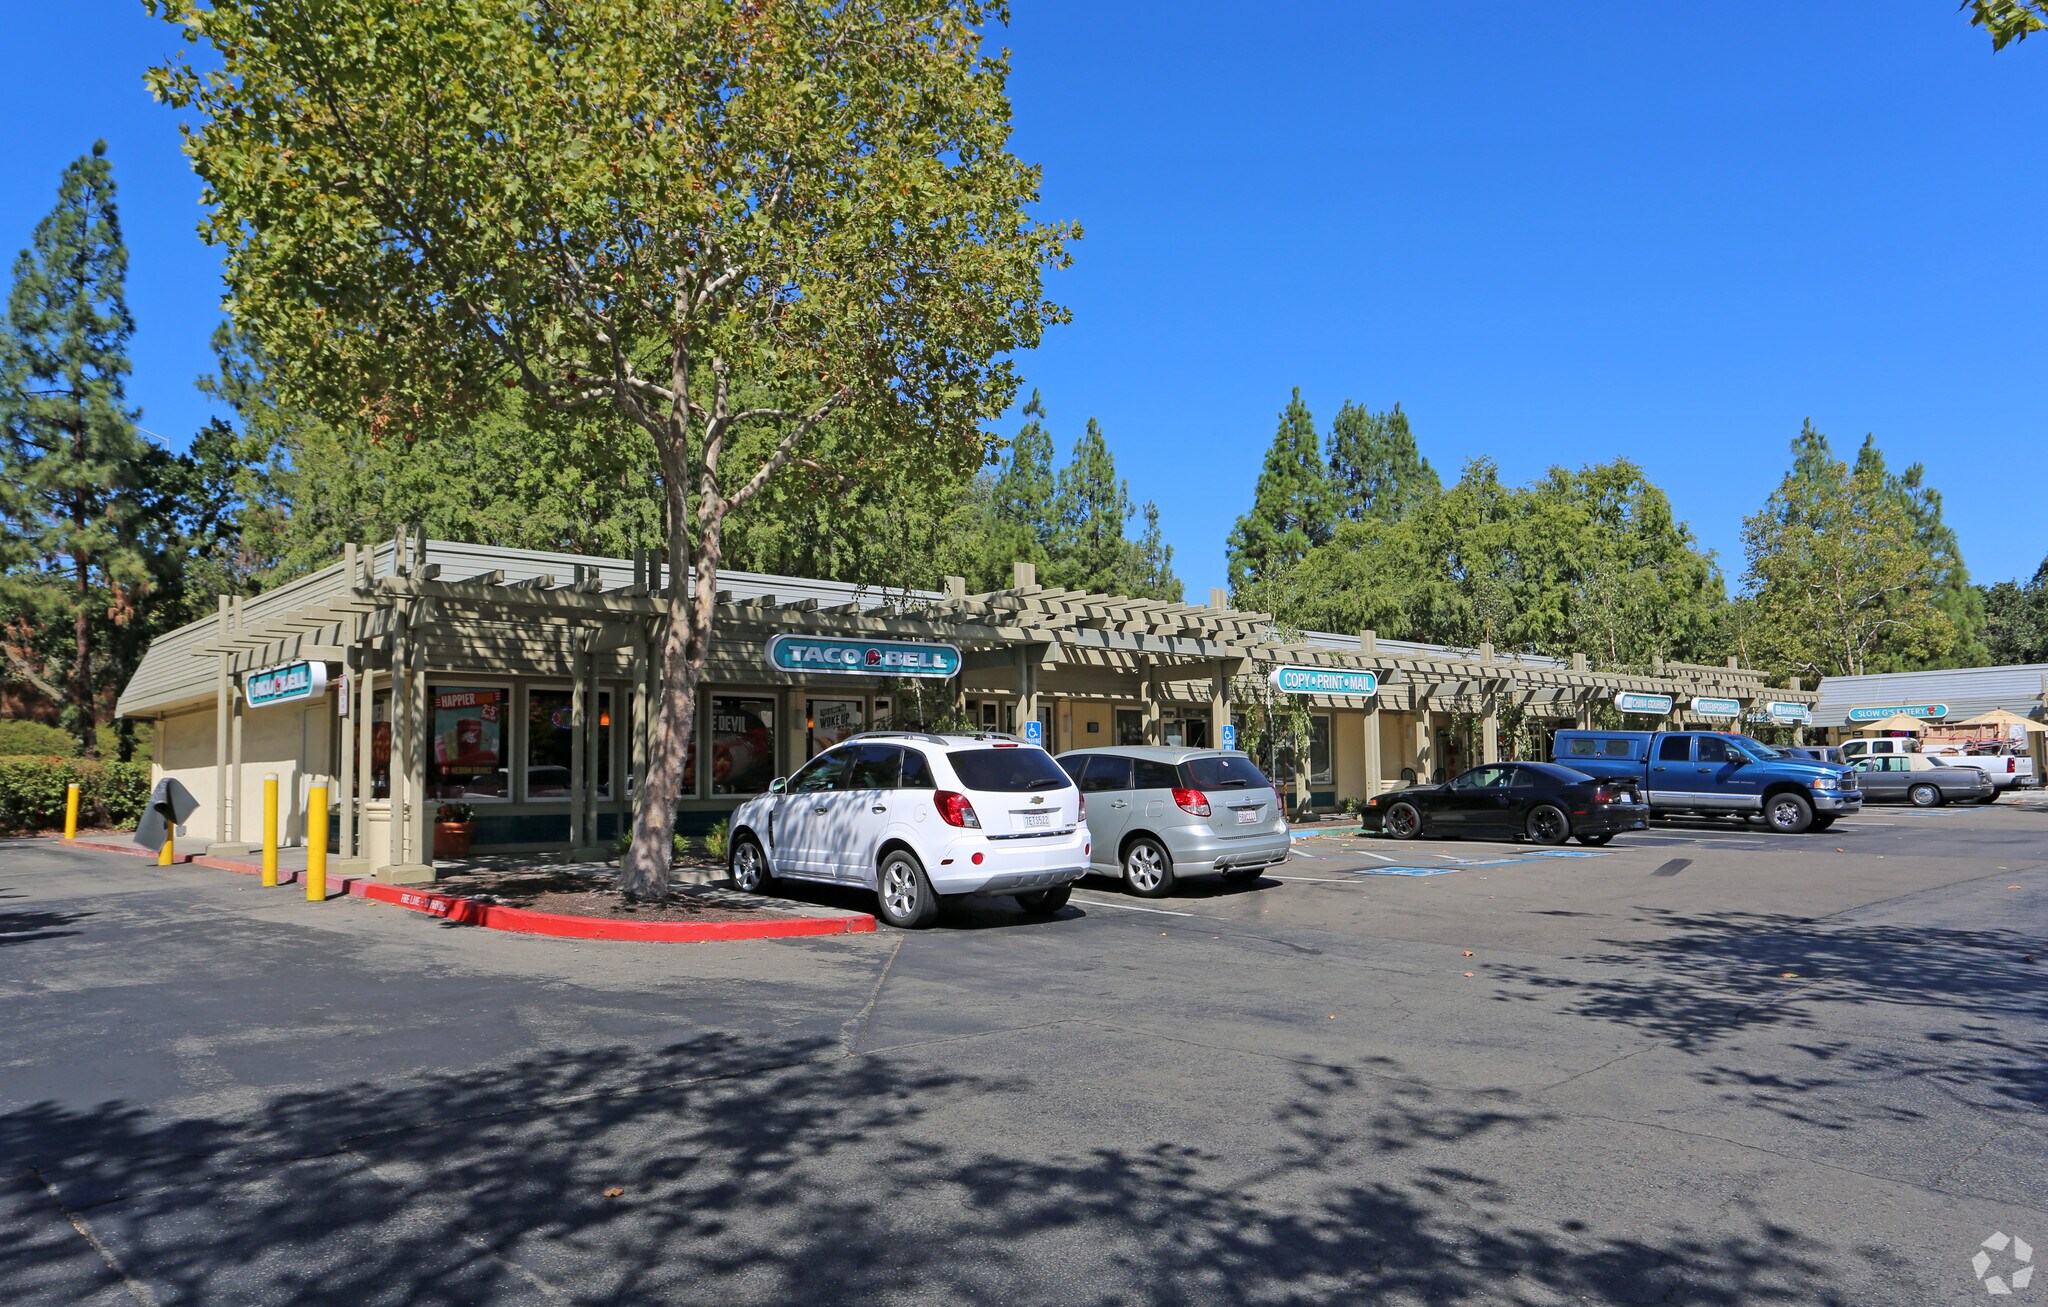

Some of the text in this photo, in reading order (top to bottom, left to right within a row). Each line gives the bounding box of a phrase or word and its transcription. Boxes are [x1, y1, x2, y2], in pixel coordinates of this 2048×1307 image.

[788, 645, 948, 668] TACO BELL
[1285, 672, 1371, 690] COPY PRINT MAIL
[441, 693, 475, 707] HAPPIER
[1632, 698, 1670, 710] CHINA GOURMET
[819, 712, 850, 729] WOKE UP
[1857, 706, 1925, 718] SLOW G'S EATERY
[718, 715, 747, 733] DEVIL
